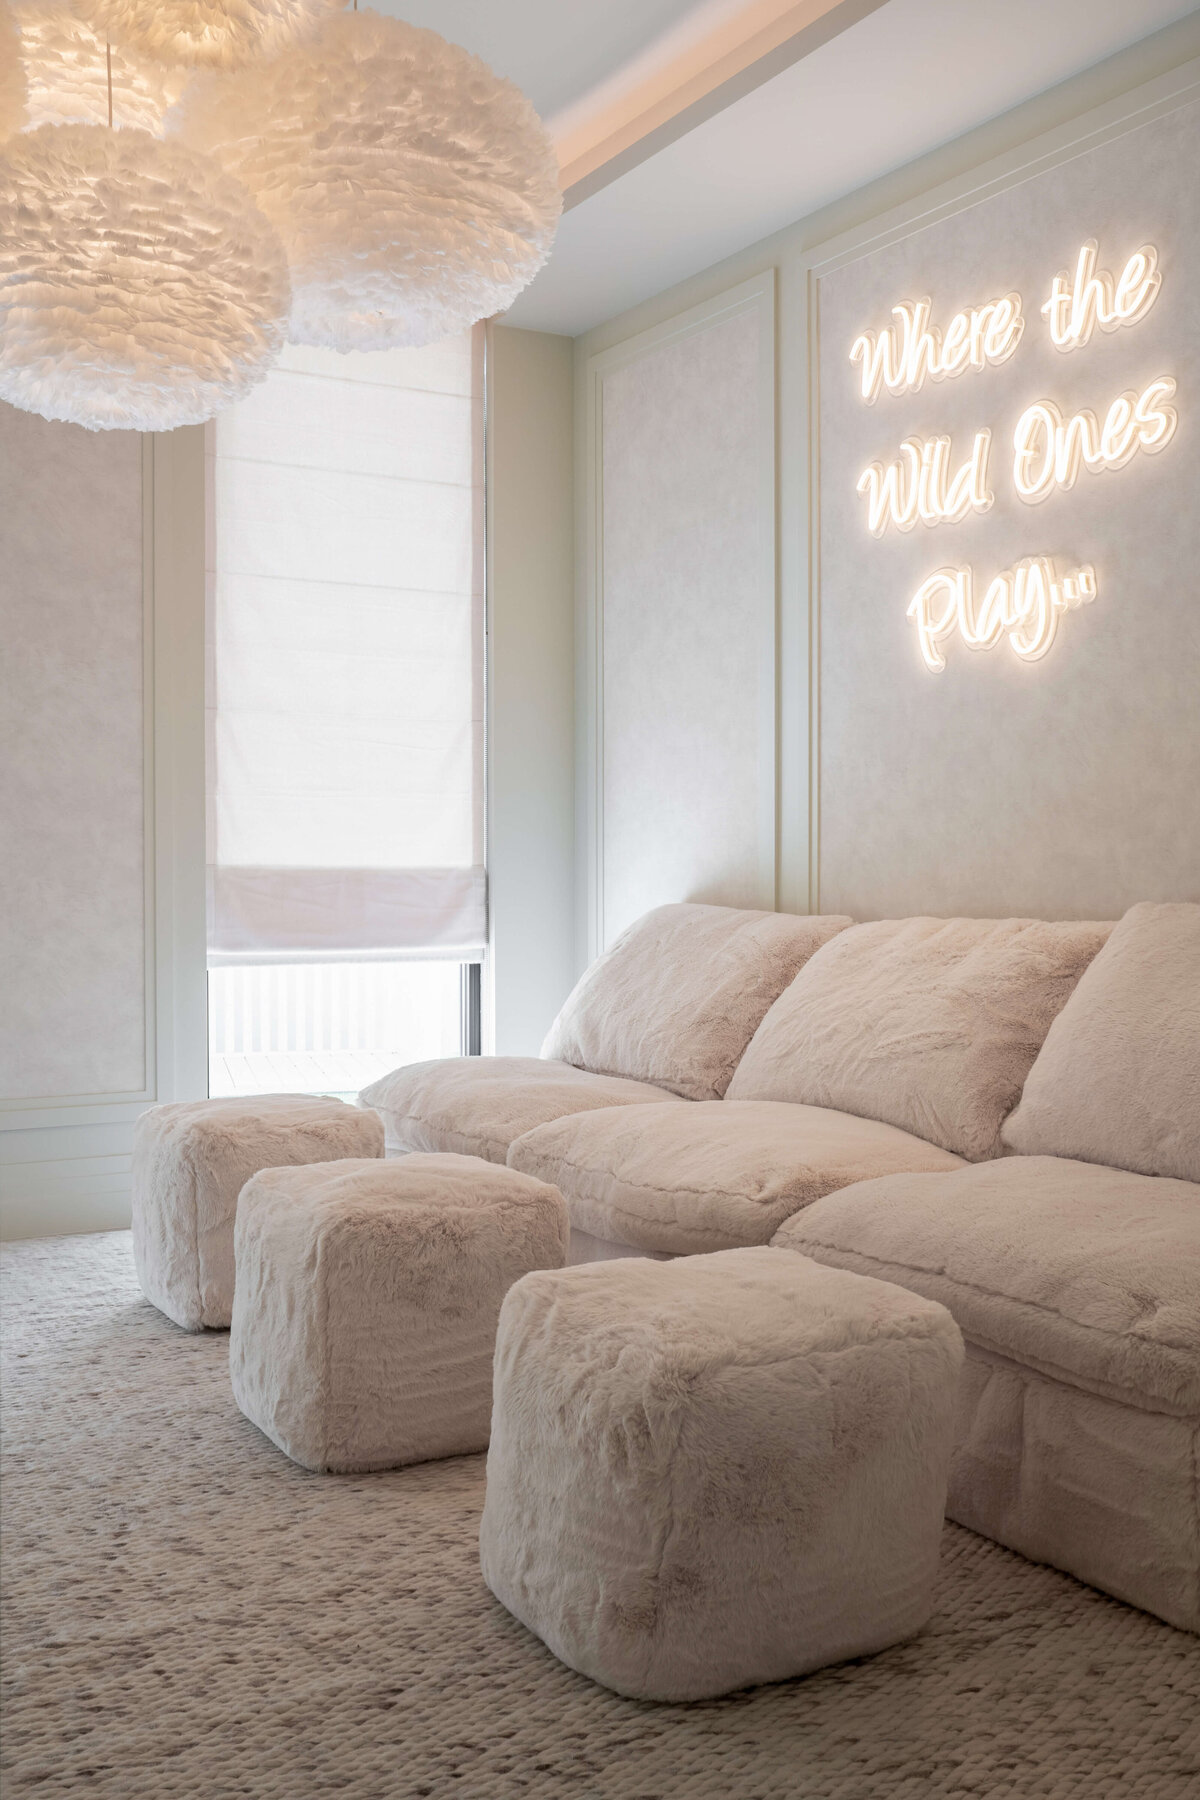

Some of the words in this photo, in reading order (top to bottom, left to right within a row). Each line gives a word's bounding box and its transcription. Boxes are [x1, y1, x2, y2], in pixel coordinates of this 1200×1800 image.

[850, 297, 1022, 401] Where
[1042, 242, 1160, 349] the
[857, 430, 993, 534] Wild
[1014, 379, 1176, 501] Ones
